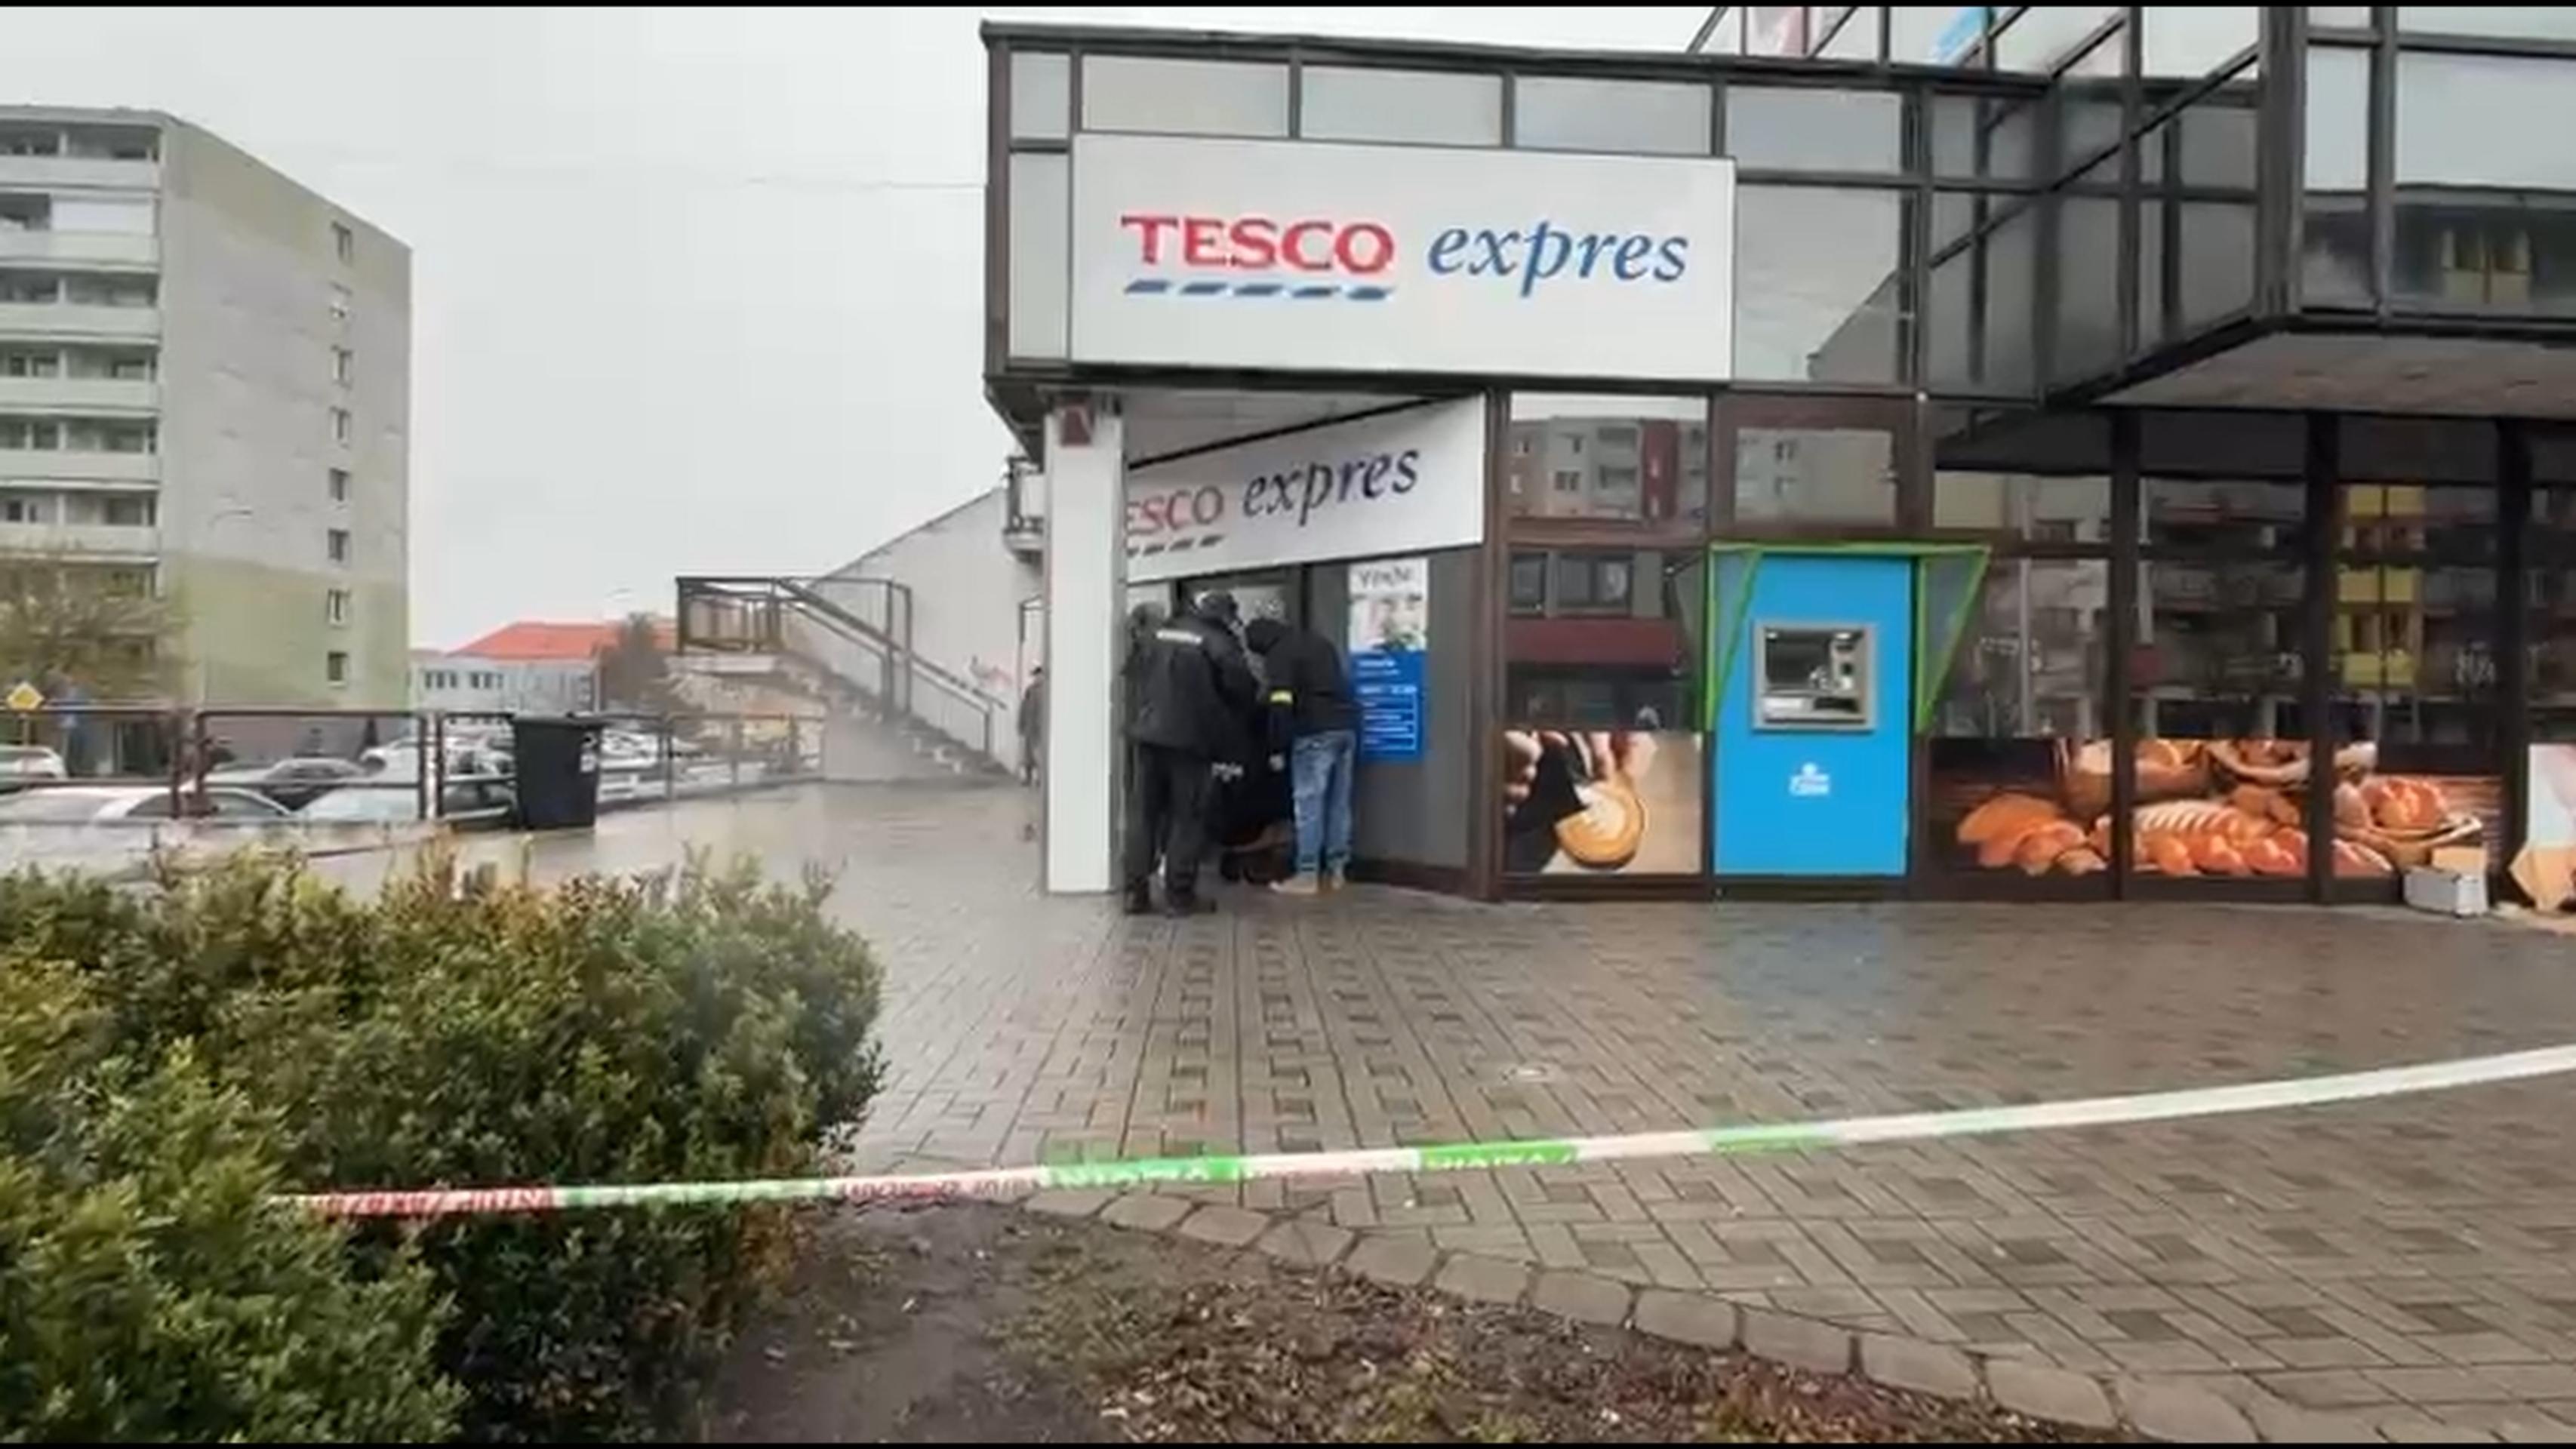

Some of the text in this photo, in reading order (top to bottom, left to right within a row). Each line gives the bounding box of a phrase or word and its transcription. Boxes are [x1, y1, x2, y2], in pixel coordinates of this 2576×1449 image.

[1120, 215, 1690, 297] TESCO expres
[1128, 450, 1419, 535] ESCO expres
